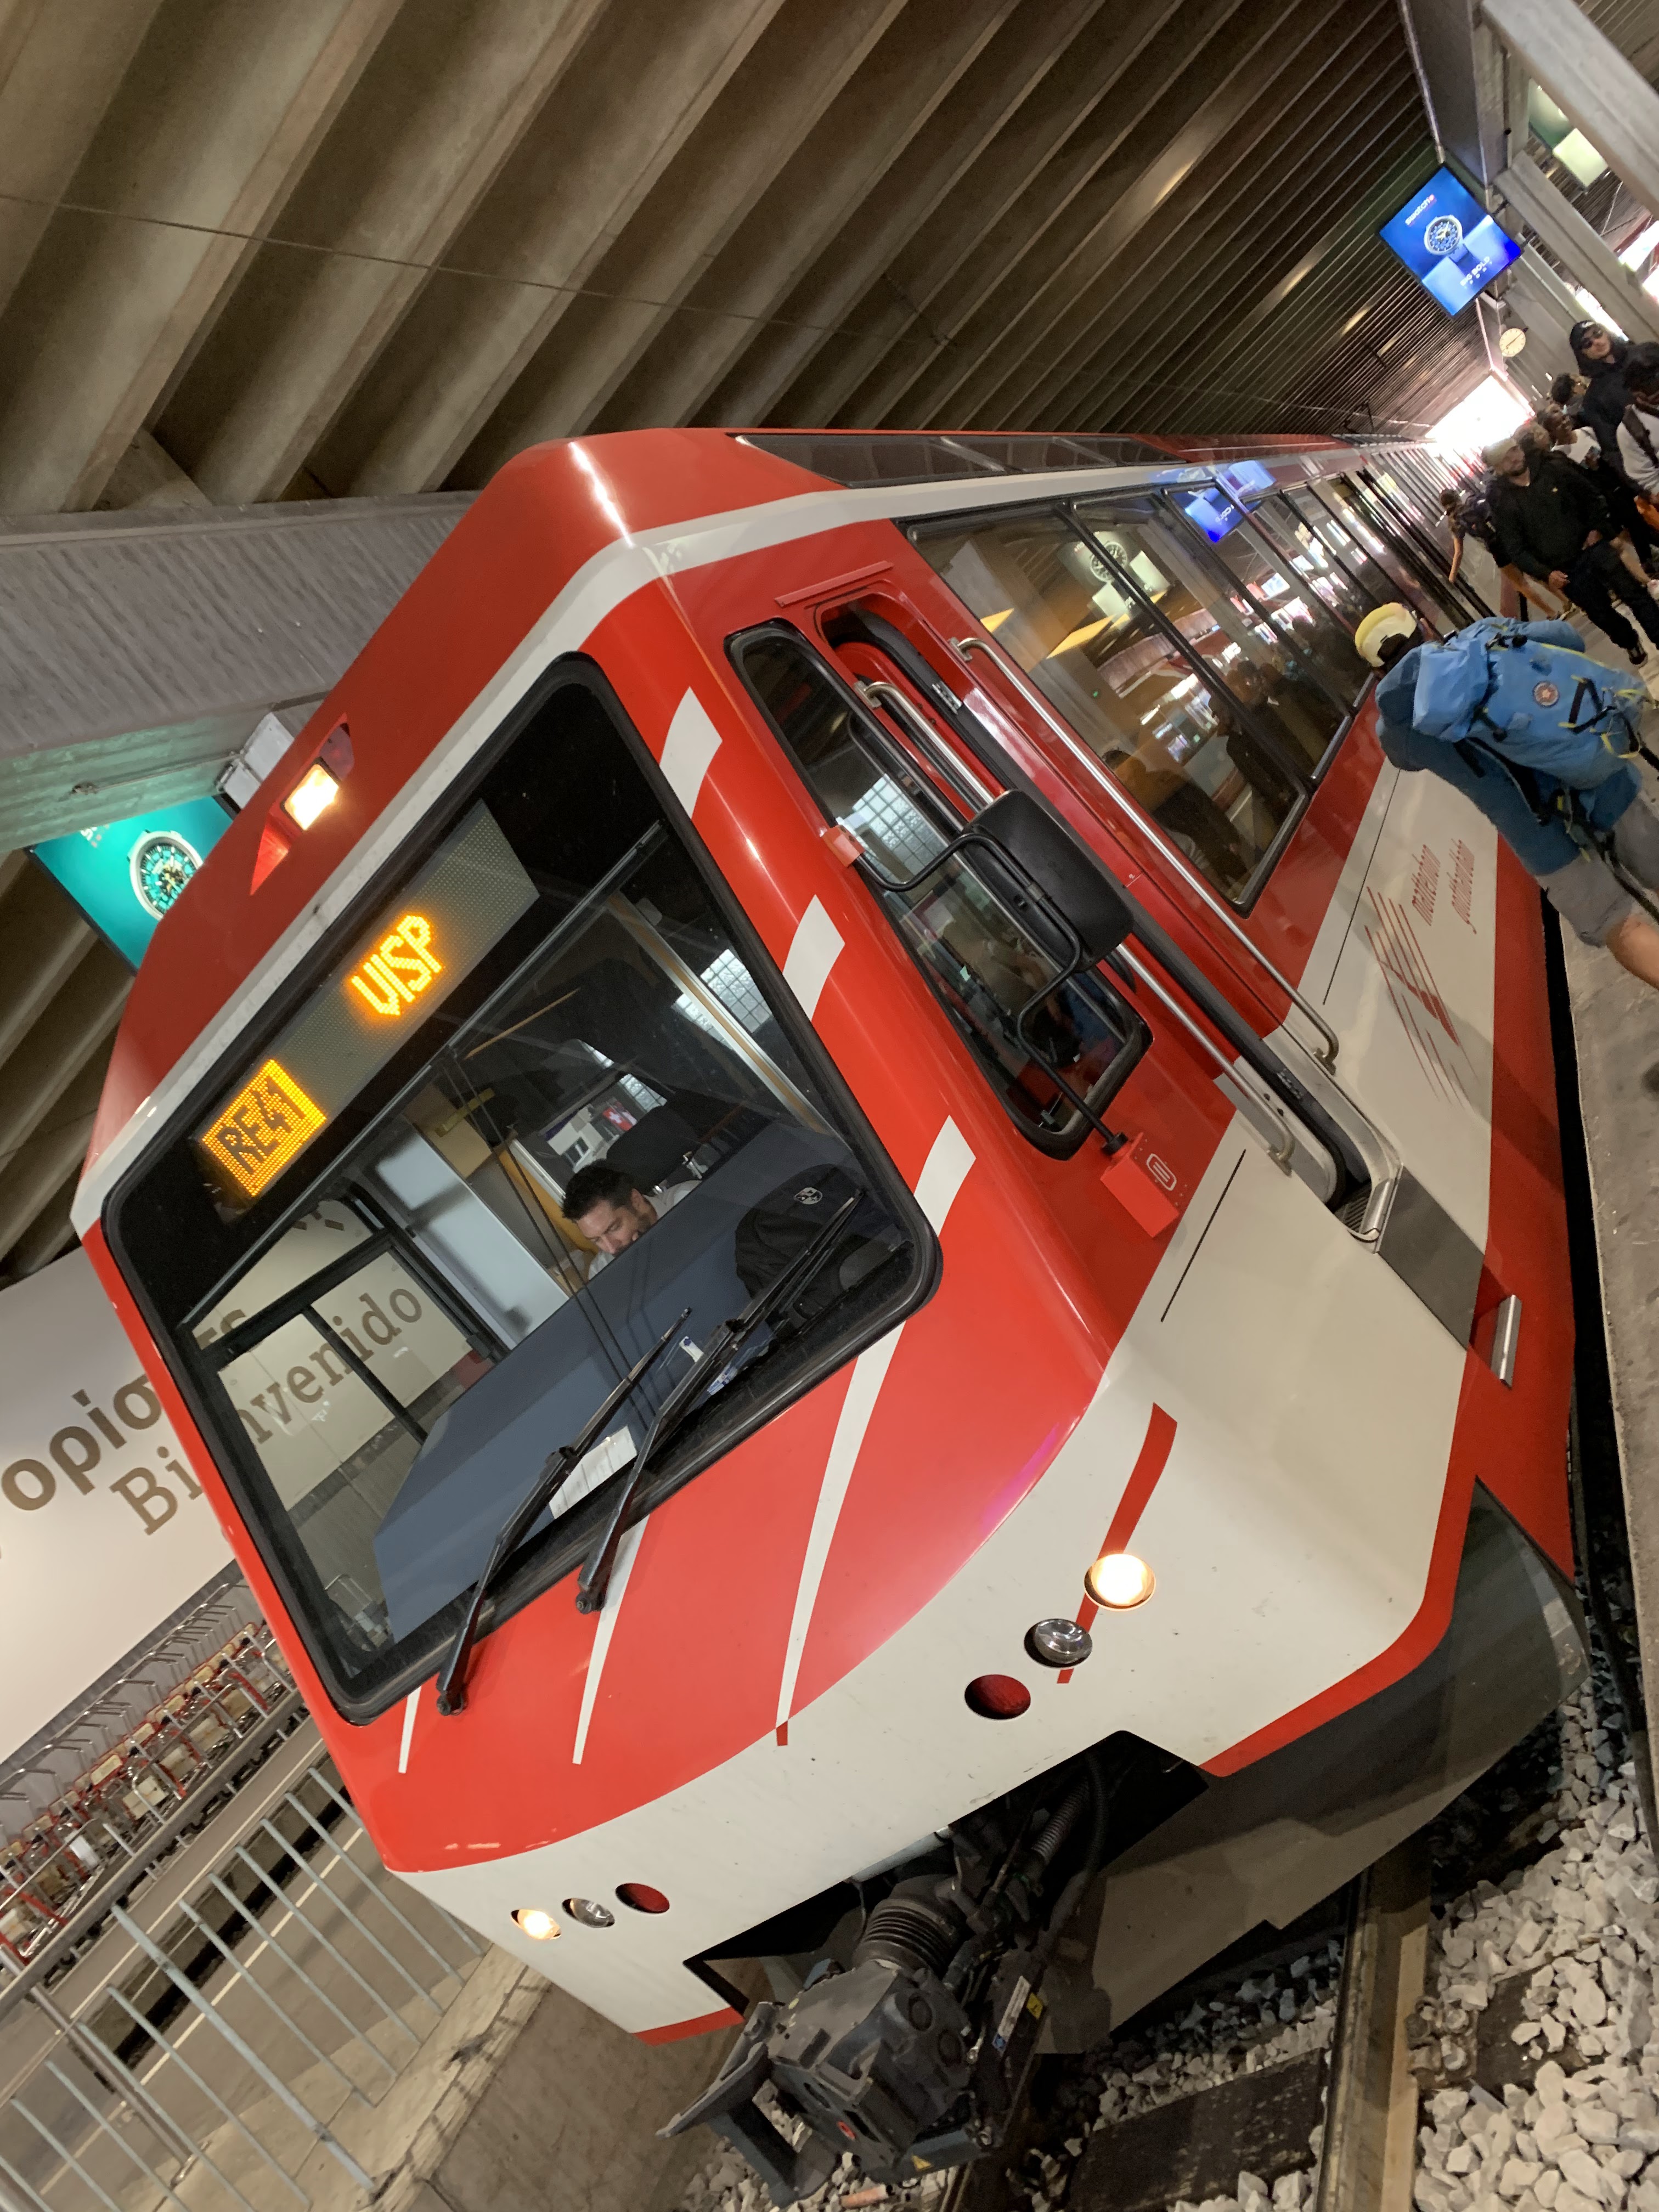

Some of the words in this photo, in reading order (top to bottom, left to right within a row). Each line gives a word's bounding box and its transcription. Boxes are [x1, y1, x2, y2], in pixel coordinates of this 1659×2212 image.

[1405, 196, 1431, 225] swatch
[351, 915, 442, 1016] VISP
[216, 1076, 306, 1174] RE41
[109, 1288, 422, 1536] Binvenido
